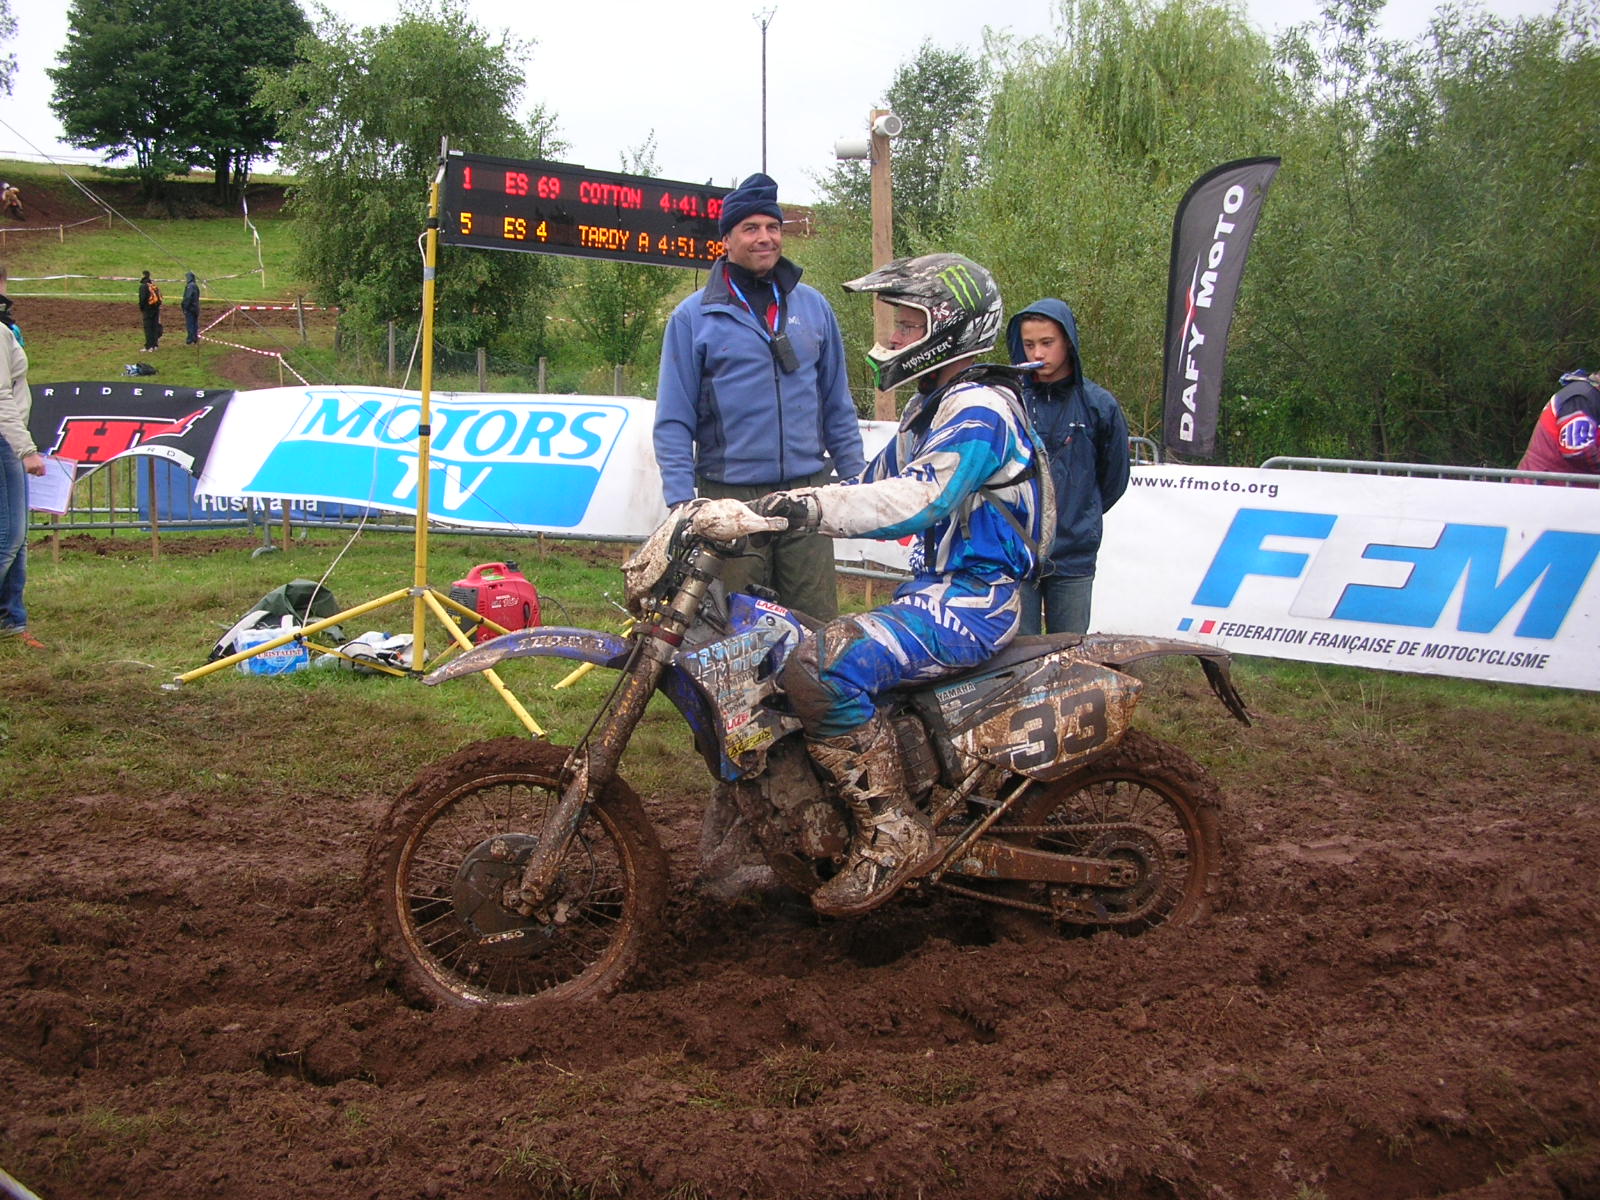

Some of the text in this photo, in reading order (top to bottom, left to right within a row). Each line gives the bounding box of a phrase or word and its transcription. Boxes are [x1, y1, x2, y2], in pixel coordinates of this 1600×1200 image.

[463, 166, 472, 190] 1
[504, 171, 529, 196] ES
[537, 176, 560, 199] 69
[579, 181, 643, 209] COTTON
[460, 211, 726, 260] 5 ES 4 TARDY A 4:51.38
[1179, 184, 1245, 442] DAFY MOTO
[901, 341, 951, 370] MONSTER
[45, 387, 205, 398] RIDERS
[300, 398, 607, 459] MOTORS
[392, 455, 493, 511] TV
[1130, 476, 1279, 498] www.ffmoto.org
[1191, 507, 1600, 640] FFM
[756, 600, 788, 616] LAZER
[1217, 622, 1550, 669] FEDERATION FRANÇAISE DE MOTOCYCLISME
[936, 682, 976, 702] YAMAHA
[1008, 688, 1108, 770] 33
